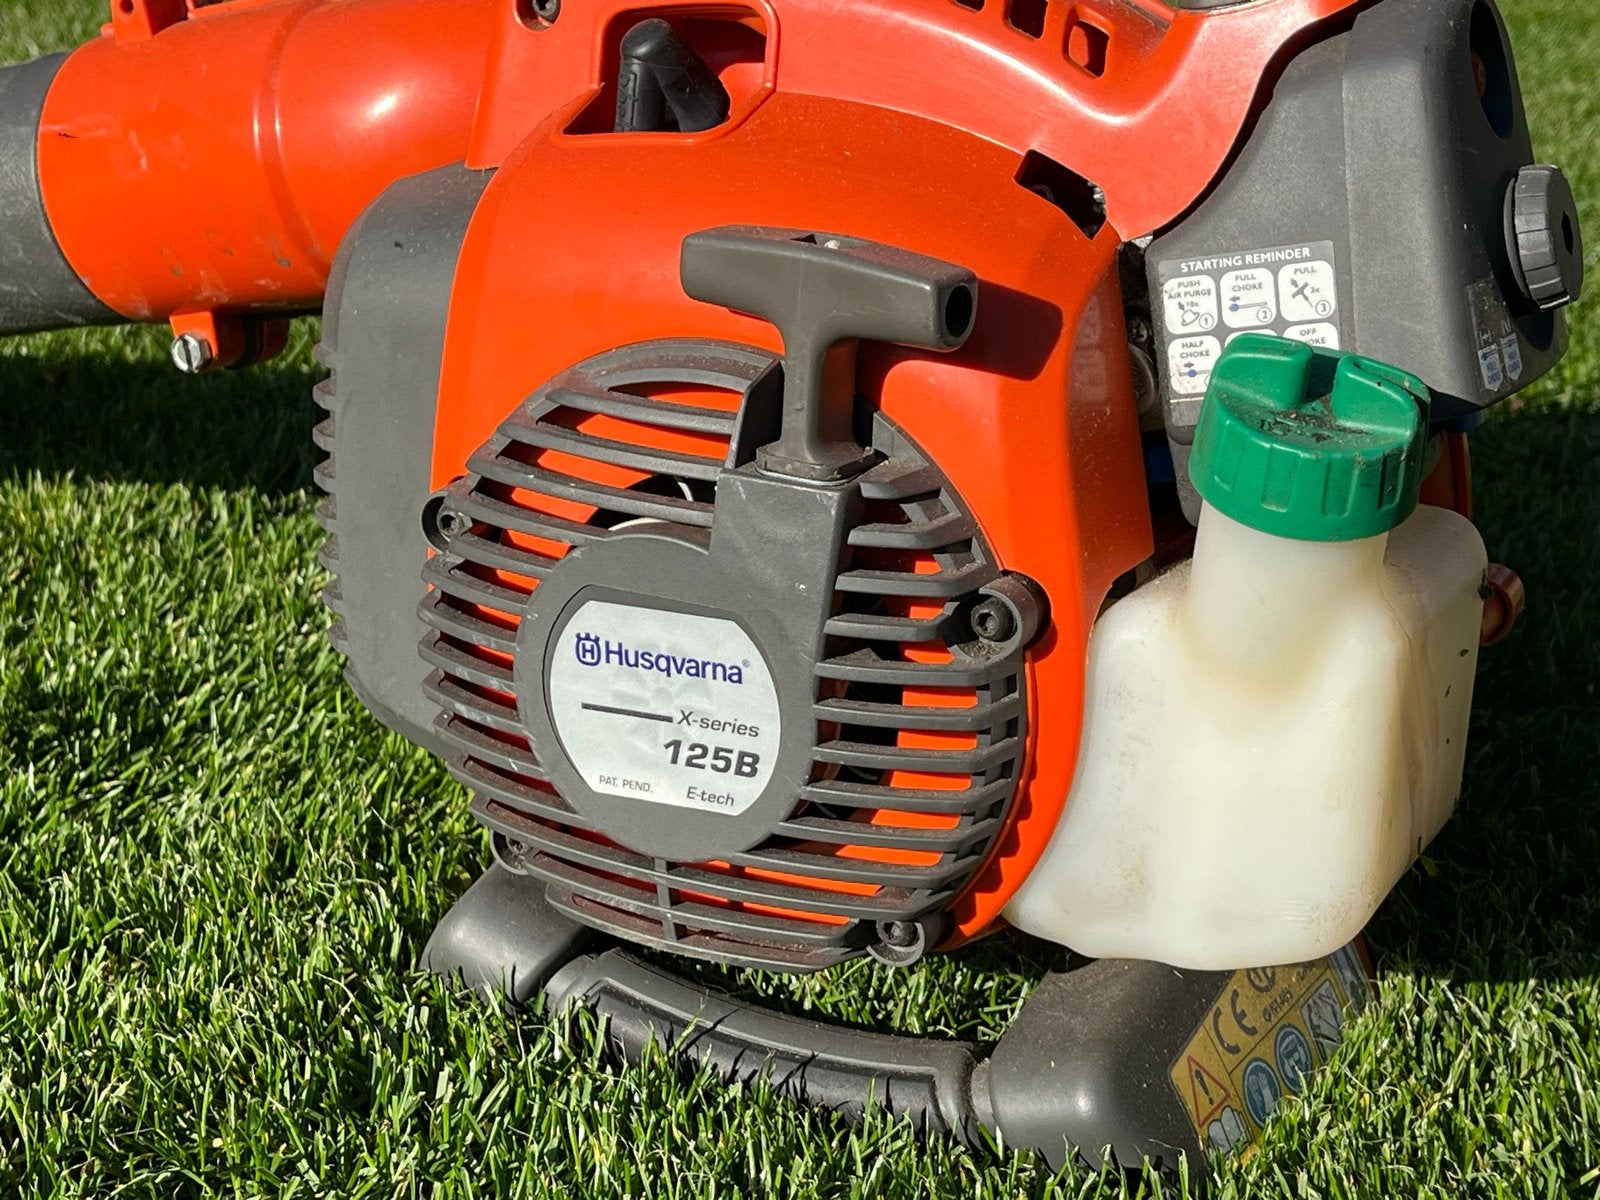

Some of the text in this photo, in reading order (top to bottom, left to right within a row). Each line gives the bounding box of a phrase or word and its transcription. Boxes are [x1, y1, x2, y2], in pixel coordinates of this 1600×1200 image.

[1181, 247, 1311, 273] STARTING REMINDER
[1294, 266, 1317, 275] PULL
[1235, 273, 1256, 282] FULL
[1177, 280, 1200, 288] PUSH
[1232, 282, 1263, 292] CHOKE
[1168, 288, 1212, 300] AIR PURGE
[1300, 328, 1316, 336] OFF
[1182, 341, 1204, 350] HALF
[1180, 350, 1210, 360] CHOKE
[677, 709, 760, 738] X-series
[663, 739, 761, 779] 125B
[599, 775, 653, 793] PAT. PEND.
[686, 786, 735, 807] E-tech
